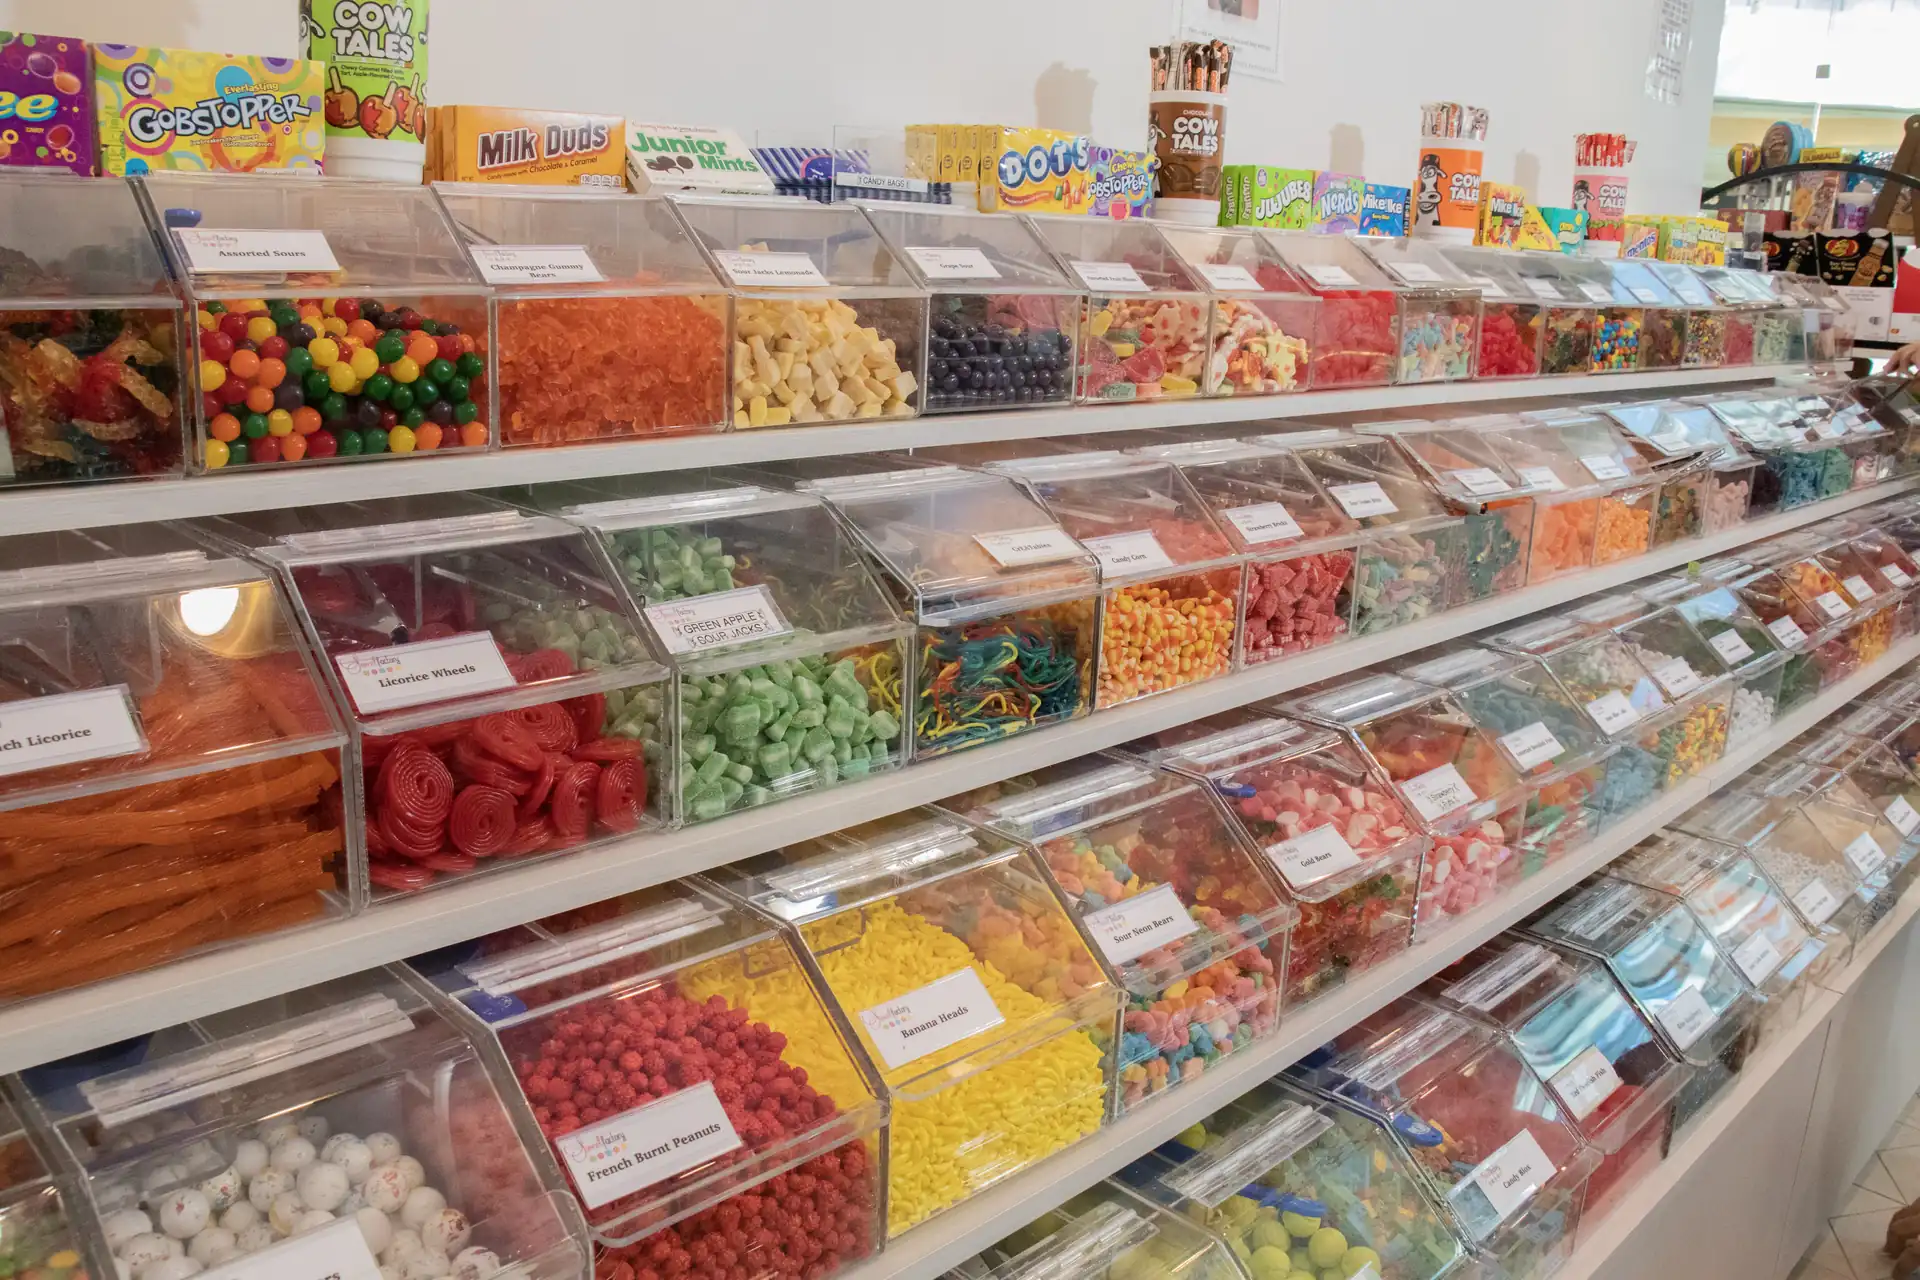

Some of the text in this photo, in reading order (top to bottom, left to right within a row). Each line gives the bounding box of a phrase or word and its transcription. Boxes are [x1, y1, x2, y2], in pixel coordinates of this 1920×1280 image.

[334, 0, 413, 34] COW
[331, 28, 414, 62] TALES
[224, 82, 279, 95] Everlasting
[1173, 116, 1219, 135] COW
[477, 122, 610, 169] Milk Duds
[631, 132, 727, 156] Junior
[1171, 133, 1219, 153] TALES
[529, 162, 564, 174] Chocolate
[569, 156, 598, 167] Caramel
[695, 154, 760, 173] Mints
[1004, 136, 1089, 184] DOTS
[1111, 160, 1138, 174] Chewy
[863, 177, 905, 188] CANDY BAGS
[1451, 172, 1482, 188] COW
[1255, 179, 1312, 220] JUJUBES
[1449, 186, 1480, 202] TALE
[1600, 185, 1627, 198] COW
[1387, 198, 1403, 214] Ike
[1491, 197, 1512, 214] Mike
[1598, 196, 1625, 209] TALE
[490, 263, 546, 271] Champagne
[1111, 555, 1131, 563] Candy
[683, 611, 757, 634] GREEN APPLE
[697, 623, 764, 645] SOUR JACKS
[378, 663, 476, 688] Licorice Wheels
[26, 728, 93, 747] Licorice
[1300, 857, 1316, 868] Gold
[1314, 851, 1332, 862] Bears
[1113, 914, 1175, 944] Sour Neon Bears
[900, 1005, 969, 1039] Banana Heads
[1594, 1067, 1607, 1078] Fish
[587, 1121, 722, 1183] French Burnt Peanuts
[1502, 1173, 1520, 1189] Candy
[1518, 1163, 1532, 1177] Blox
